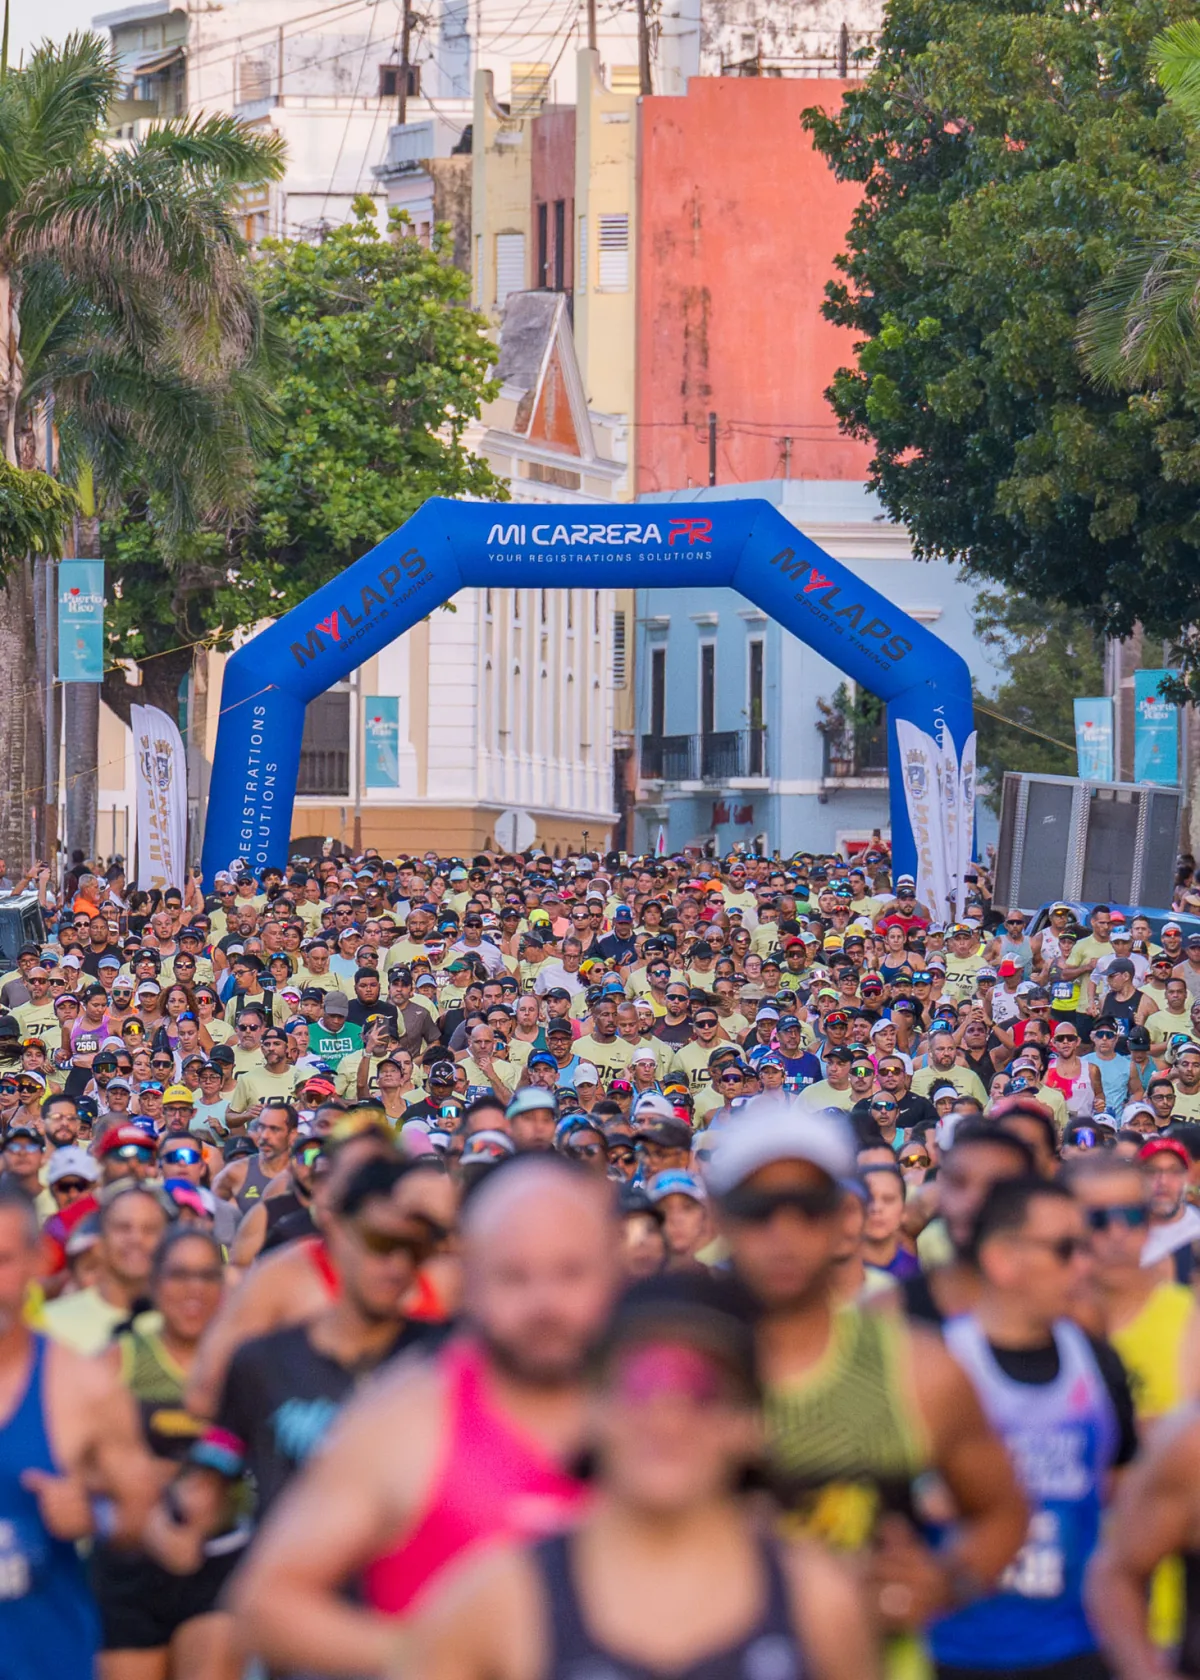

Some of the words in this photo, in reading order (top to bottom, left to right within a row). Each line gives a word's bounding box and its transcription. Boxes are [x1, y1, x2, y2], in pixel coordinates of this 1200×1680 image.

[486, 524, 526, 545] MI
[531, 523, 662, 546] CARRERA
[668, 518, 713, 546] PR
[488, 554, 522, 563] YOUR
[529, 553, 632, 563] REGISTRATIONS
[639, 551, 712, 562] SOLUTIONS
[289, 547, 427, 668] MYLAPS
[339, 608, 389, 651] SPORTS
[392, 571, 435, 608] TIMING
[769, 547, 913, 662] MYLAPS
[793, 592, 845, 635] SPORTS
[847, 635, 892, 671] TIMING
[254, 762, 277, 875] SOLUTIONS
[76, 1040, 97, 1052] 2560
[321, 1039, 351, 1051] MCS
